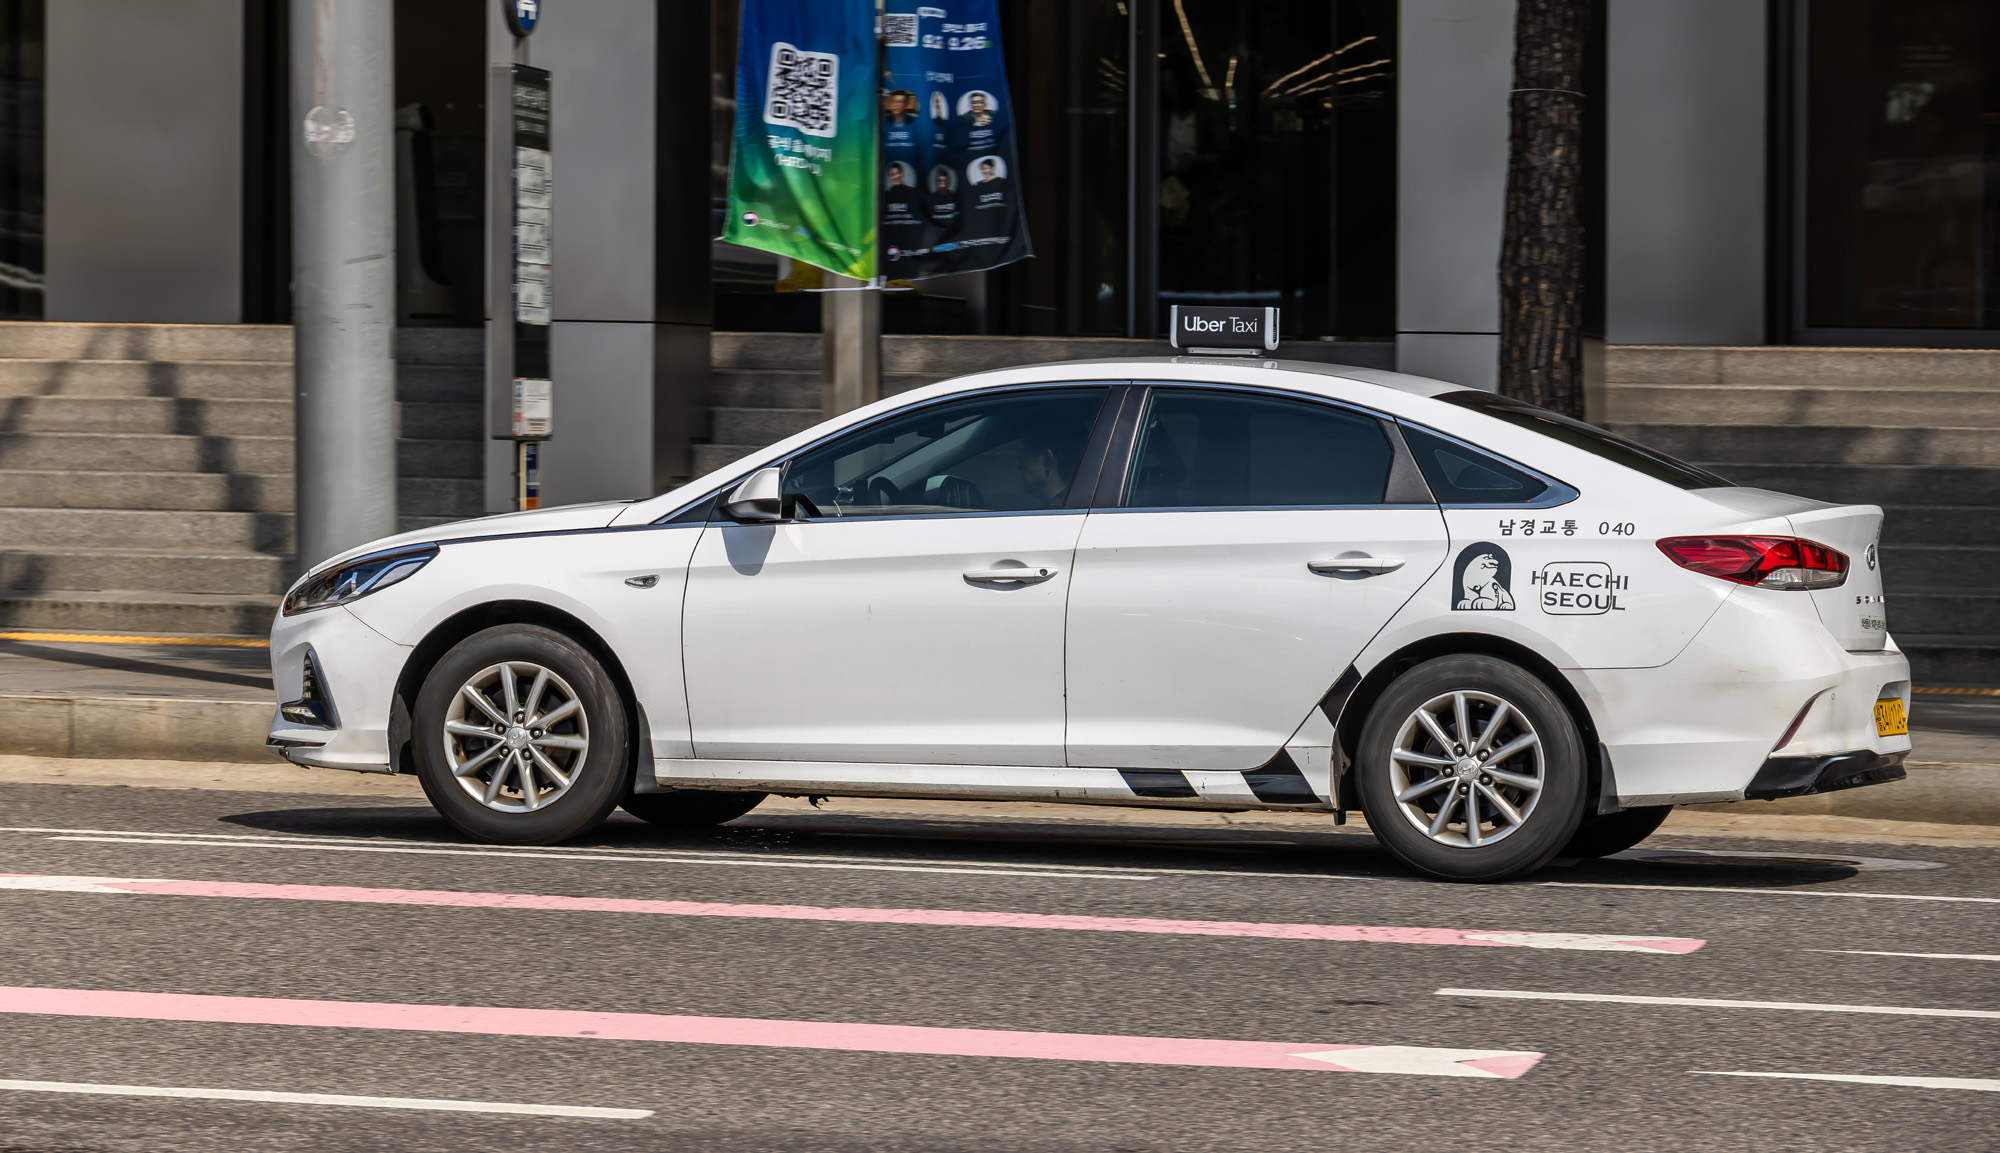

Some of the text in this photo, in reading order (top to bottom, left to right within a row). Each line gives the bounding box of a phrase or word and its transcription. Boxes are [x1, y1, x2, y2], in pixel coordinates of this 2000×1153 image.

[1184, 316, 1257, 333] Uber Taxi
[1499, 519, 1635, 536] 남경교통 040
[1531, 570, 1629, 590] HAECHI
[1543, 591, 1626, 611] SEOUL
